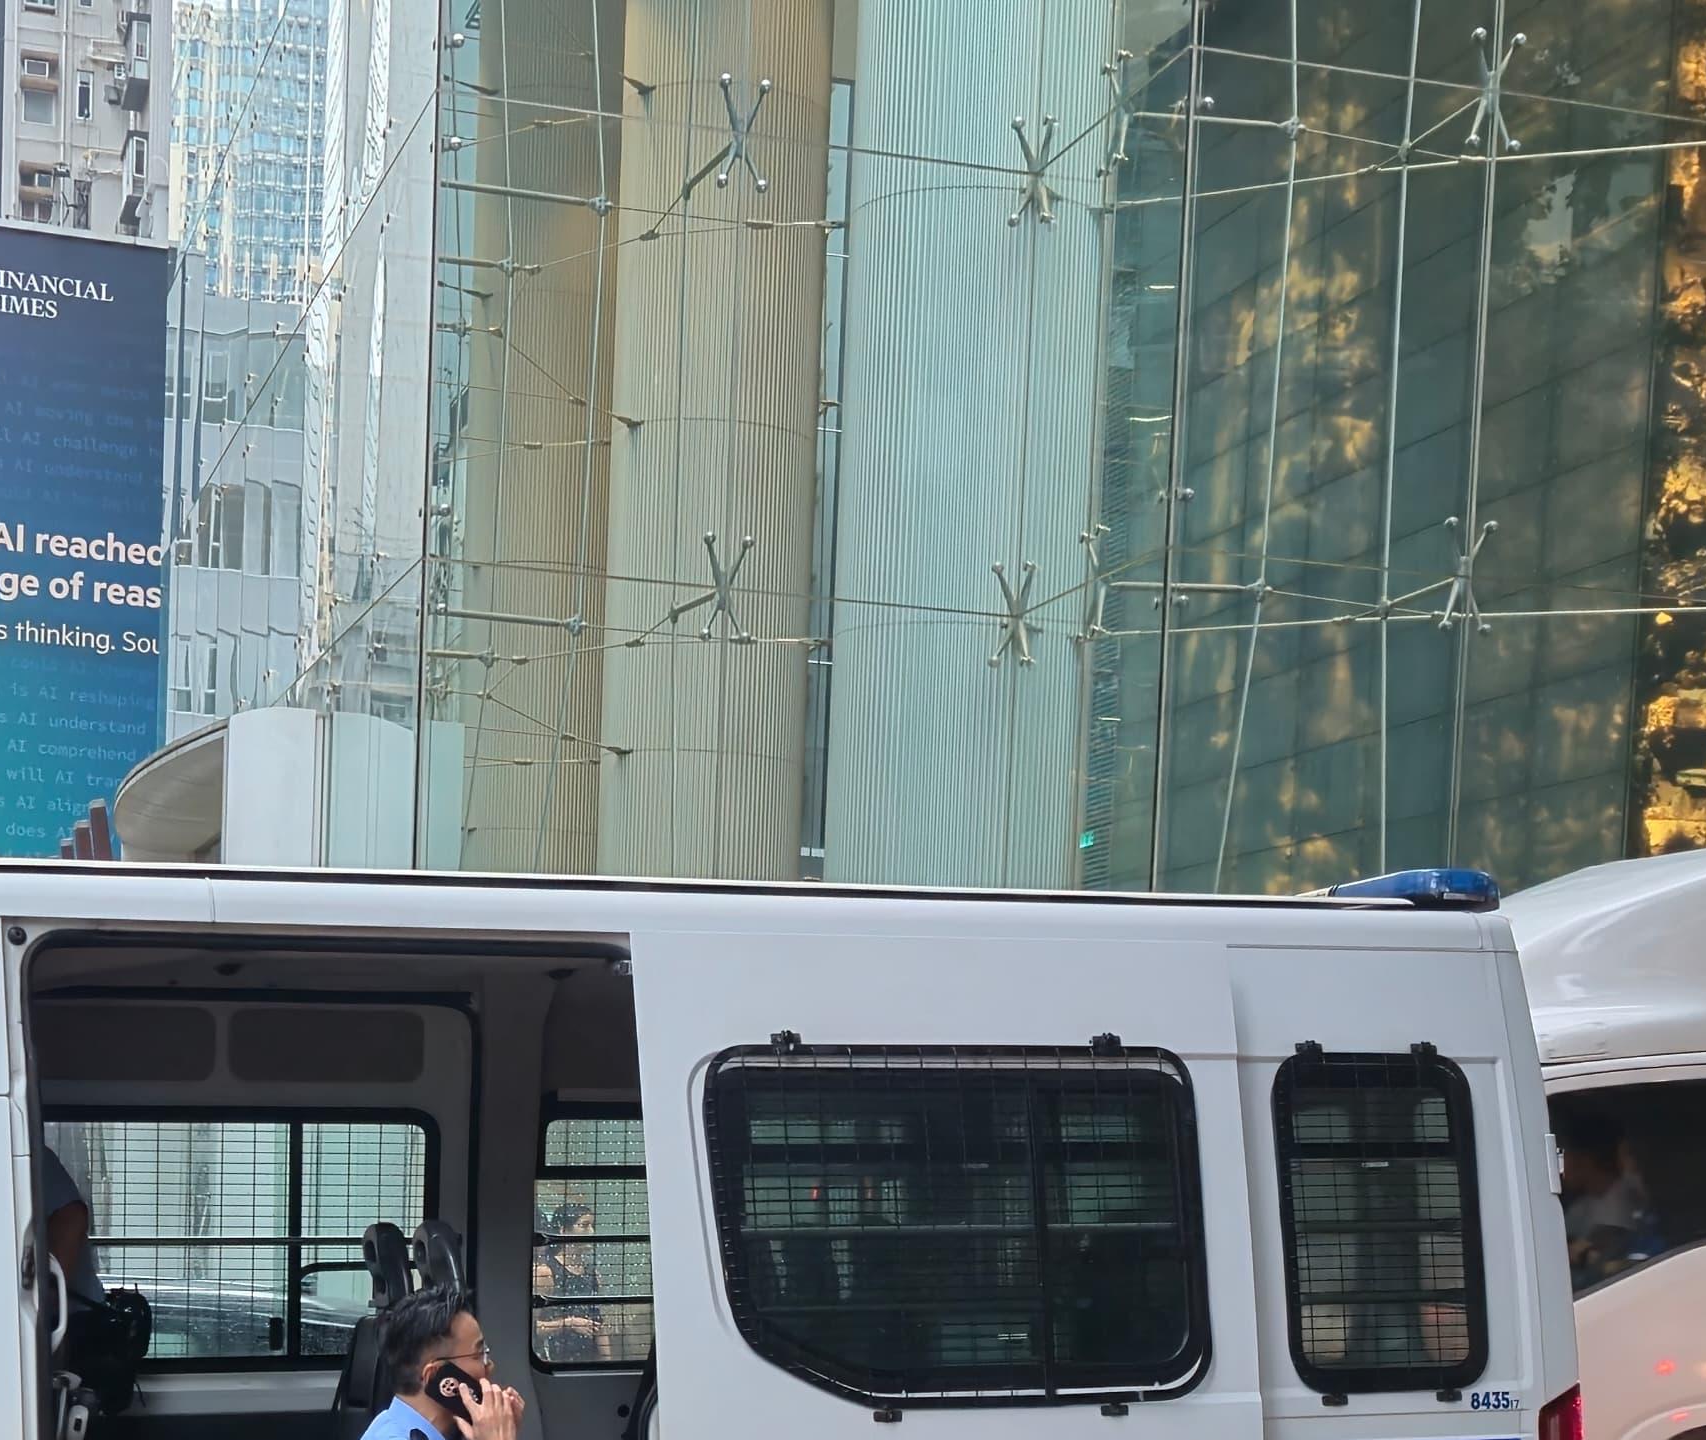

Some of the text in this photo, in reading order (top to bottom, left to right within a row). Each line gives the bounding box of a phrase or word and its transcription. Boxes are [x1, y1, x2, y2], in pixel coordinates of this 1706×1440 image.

[53, 432, 138, 459] challenge
[49, 571, 85, 601] of
[94, 582, 161, 609] reas
[15, 620, 115, 654] thinking.
[12, 683, 29, 697] is
[38, 687, 58, 701] AI
[69, 691, 156, 712] reshaping
[18, 711, 37, 726] AI
[49, 715, 147, 736] understand
[7, 738, 28, 753] AI
[38, 743, 136, 762] comprehend
[6, 767, 45, 784] will
[55, 771, 75, 786] AI
[16, 796, 36, 810] AI
[6, 822, 46, 838] does
[1471, 1391, 1510, 1410] 8435
